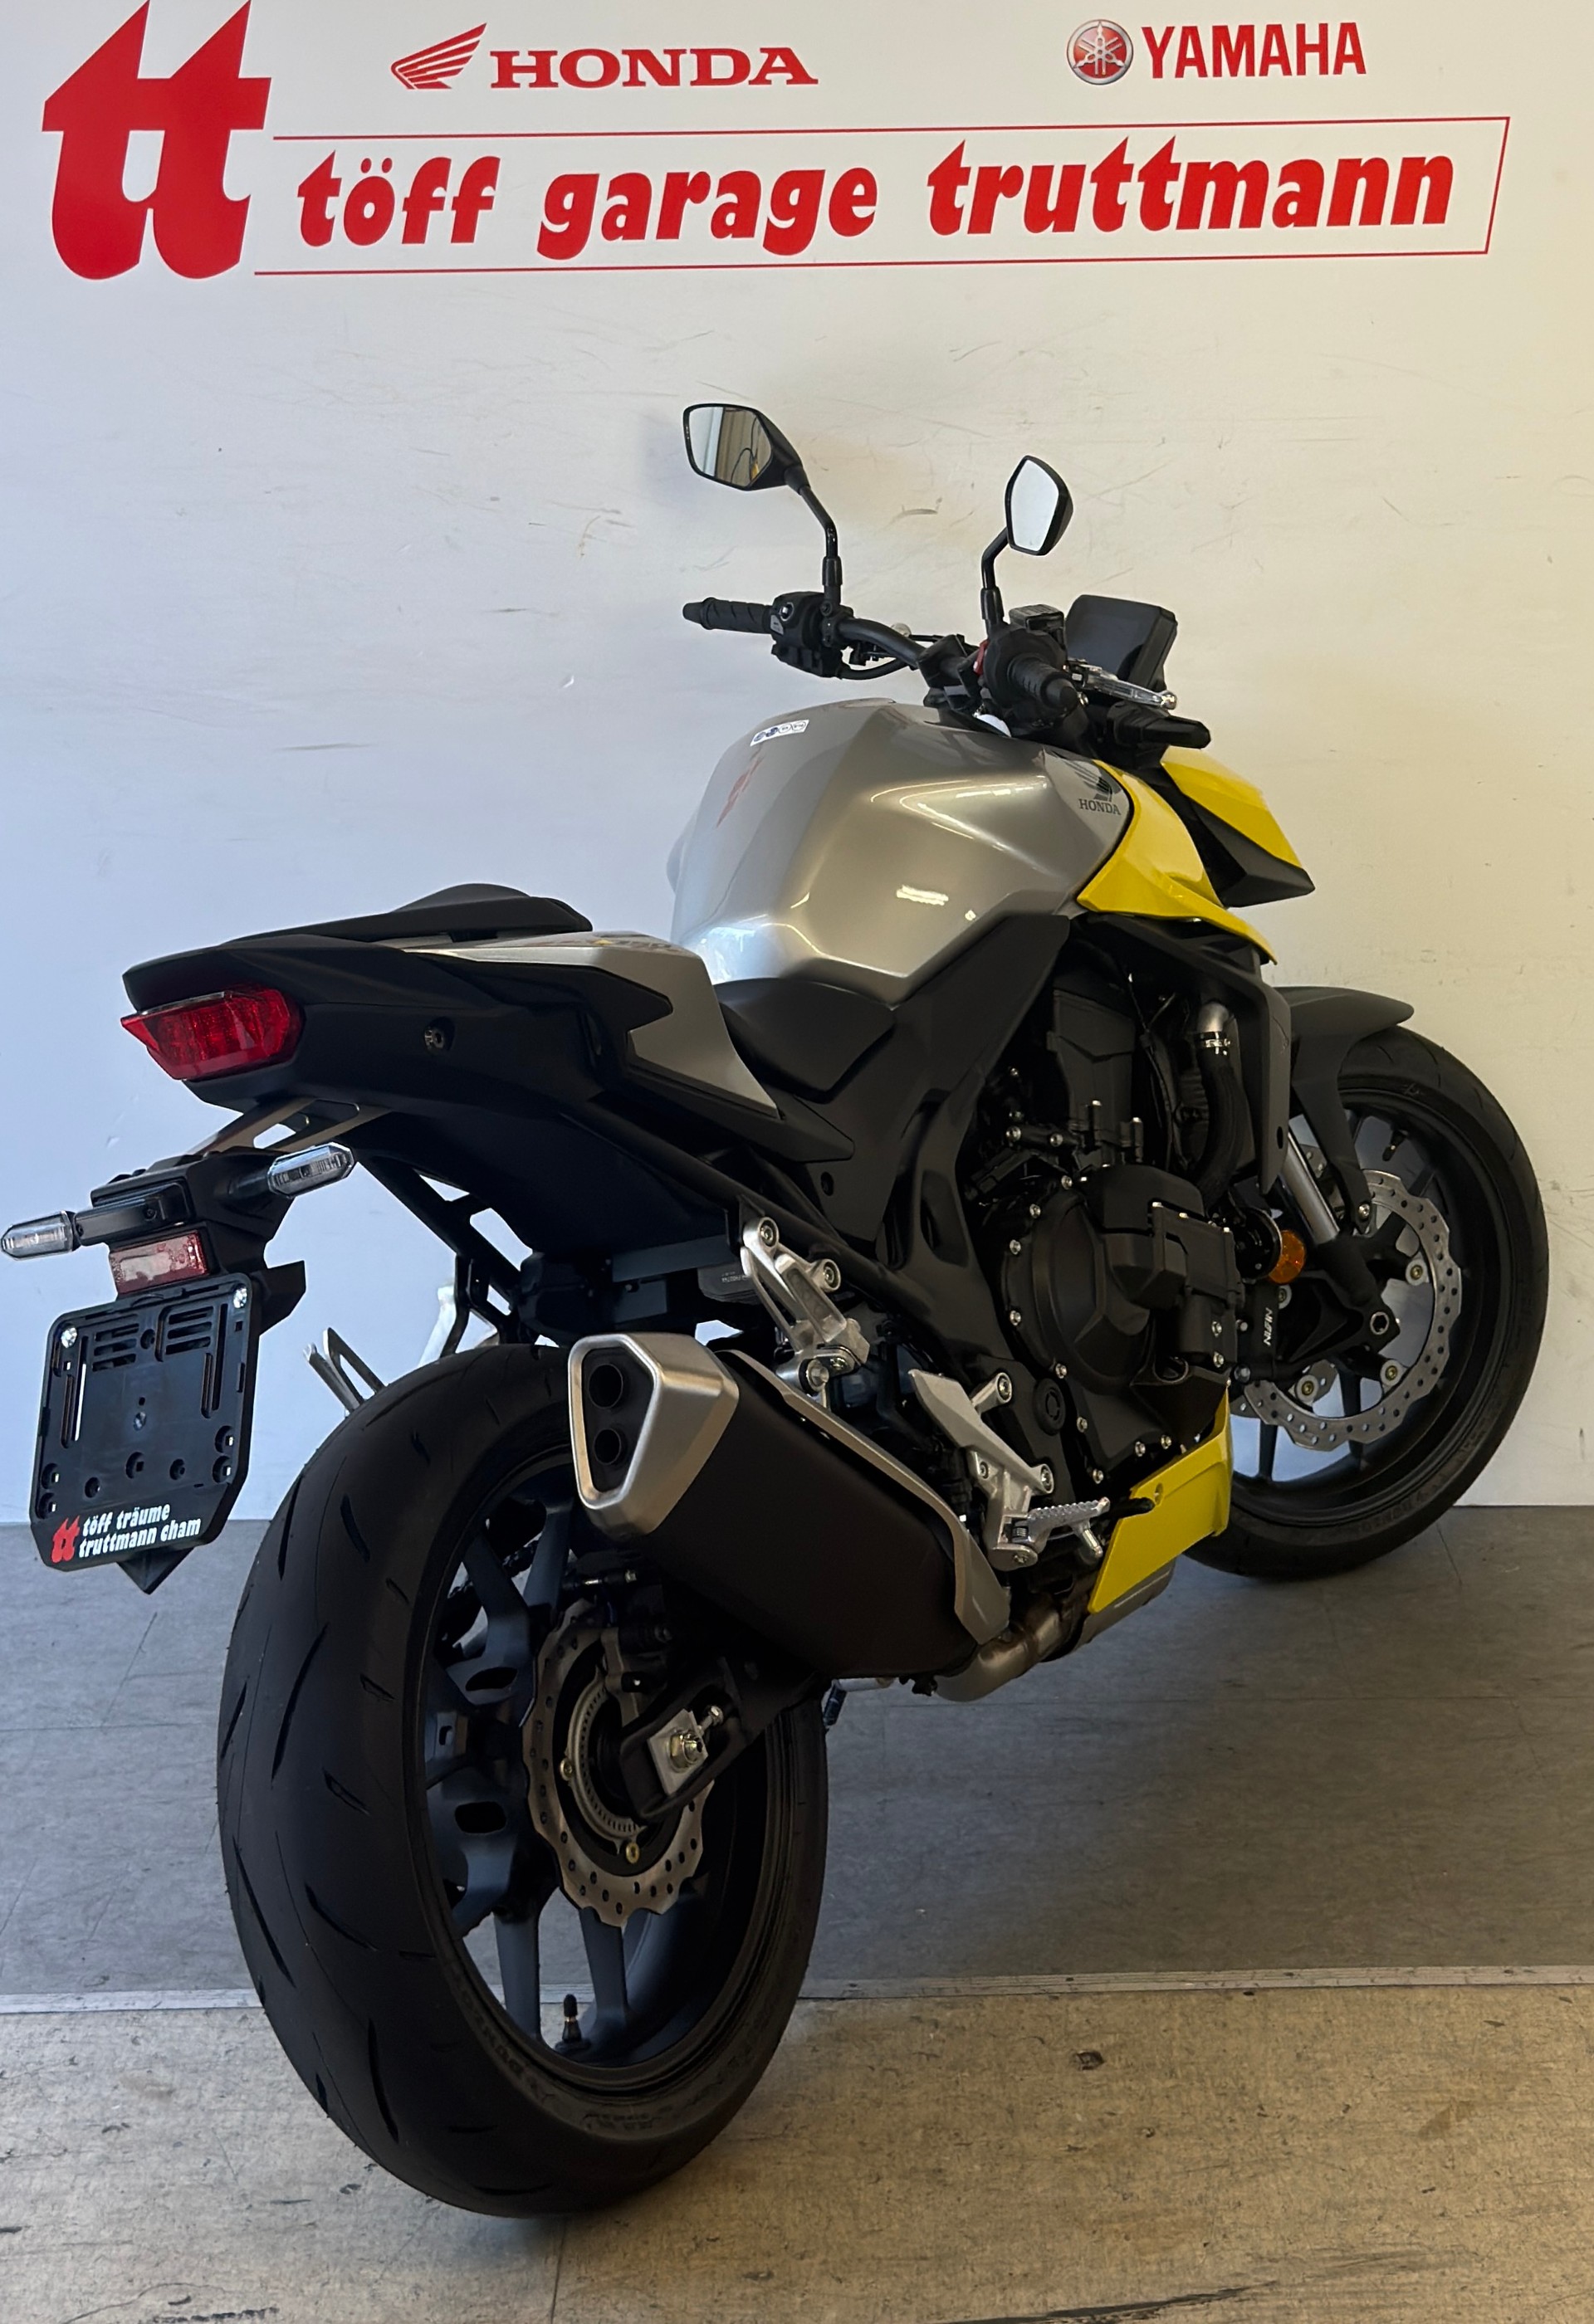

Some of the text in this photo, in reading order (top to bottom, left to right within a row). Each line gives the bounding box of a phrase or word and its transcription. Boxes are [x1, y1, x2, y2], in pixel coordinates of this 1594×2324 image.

[490, 46, 819, 90] HONDA
[1141, 22, 1367, 80] YAMAHA
[297, 136, 1455, 261] töff garage truttmann
[1078, 798, 1122, 816] HONDA
[78, 1518, 202, 1559] truttmann cham
[82, 1503, 171, 1537] töff träume
